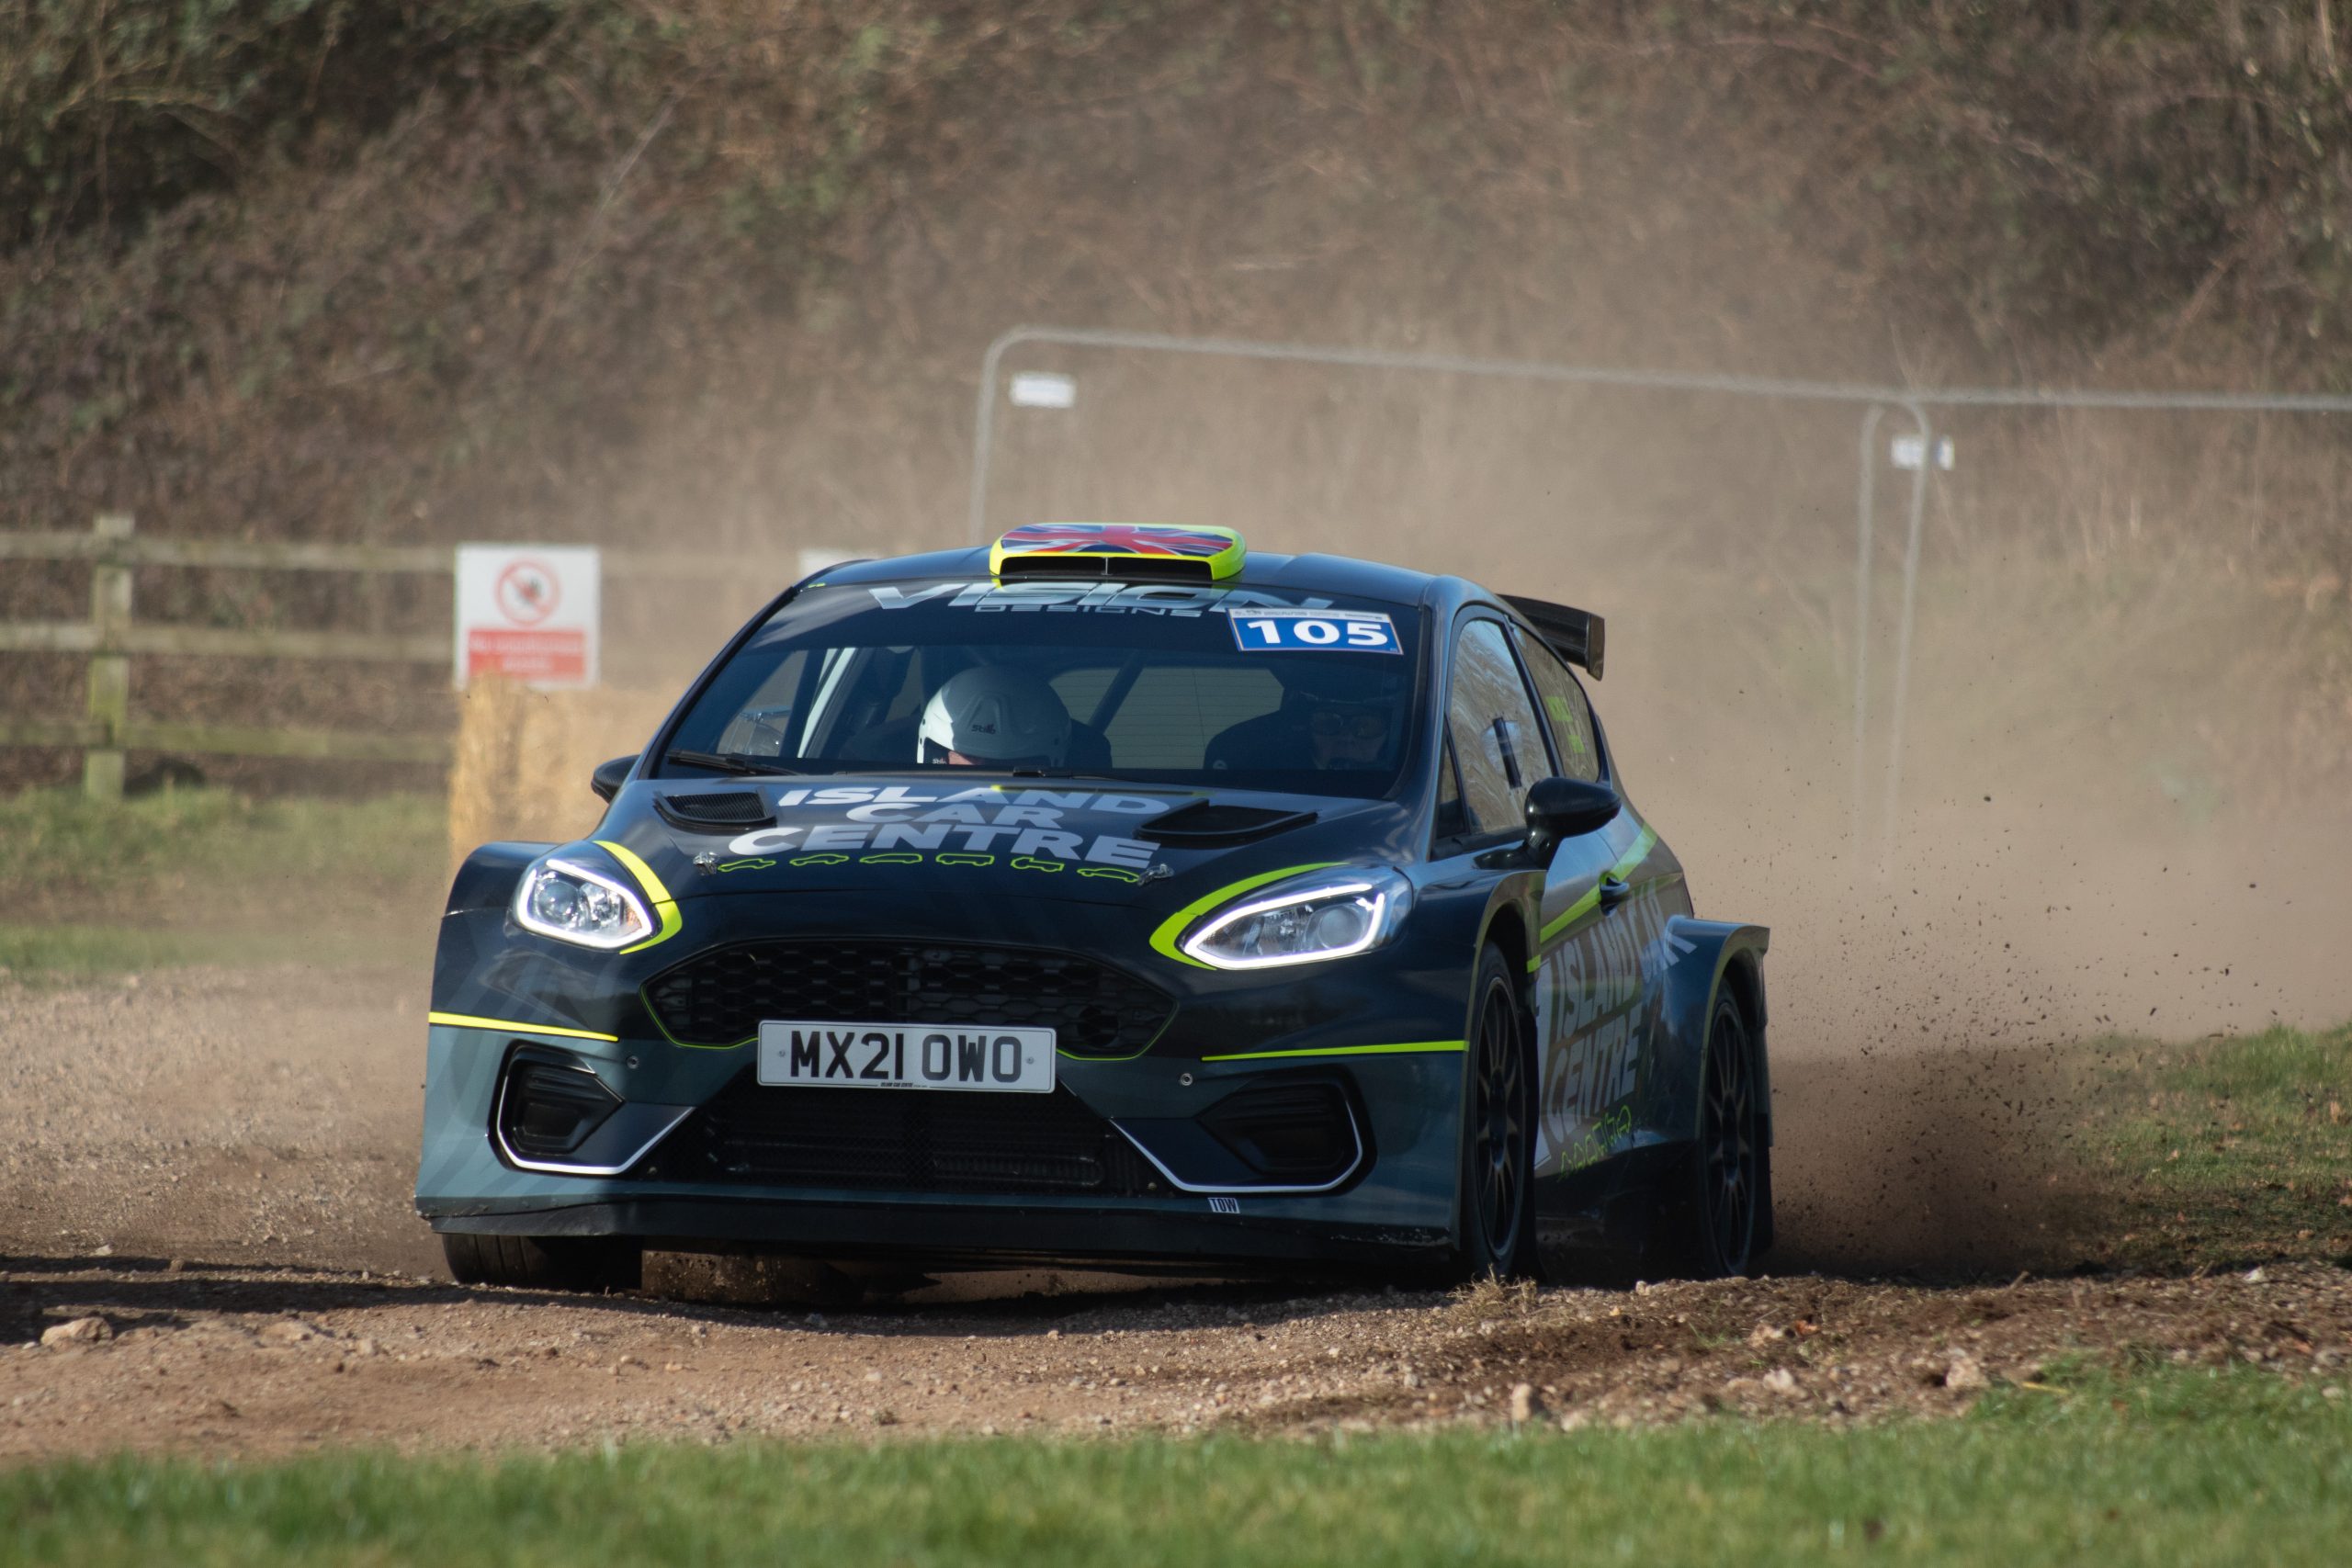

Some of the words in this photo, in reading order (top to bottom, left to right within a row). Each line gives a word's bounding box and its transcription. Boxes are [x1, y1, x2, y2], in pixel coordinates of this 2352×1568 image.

[868, 582, 1333, 613] VISION
[975, 604, 1203, 618] DESIGNS
[1247, 619, 1389, 646] 105
[778, 786, 1170, 815] ISLAND
[845, 803, 1066, 829] CAR
[728, 823, 1161, 867] CENTRE
[1555, 911, 1636, 1043] ISLAND
[790, 1030, 904, 1080] MX21
[922, 1033, 1023, 1083] OWO
[1547, 1003, 1643, 1144] CENTRE
[1209, 1198, 1238, 1213] TOW
